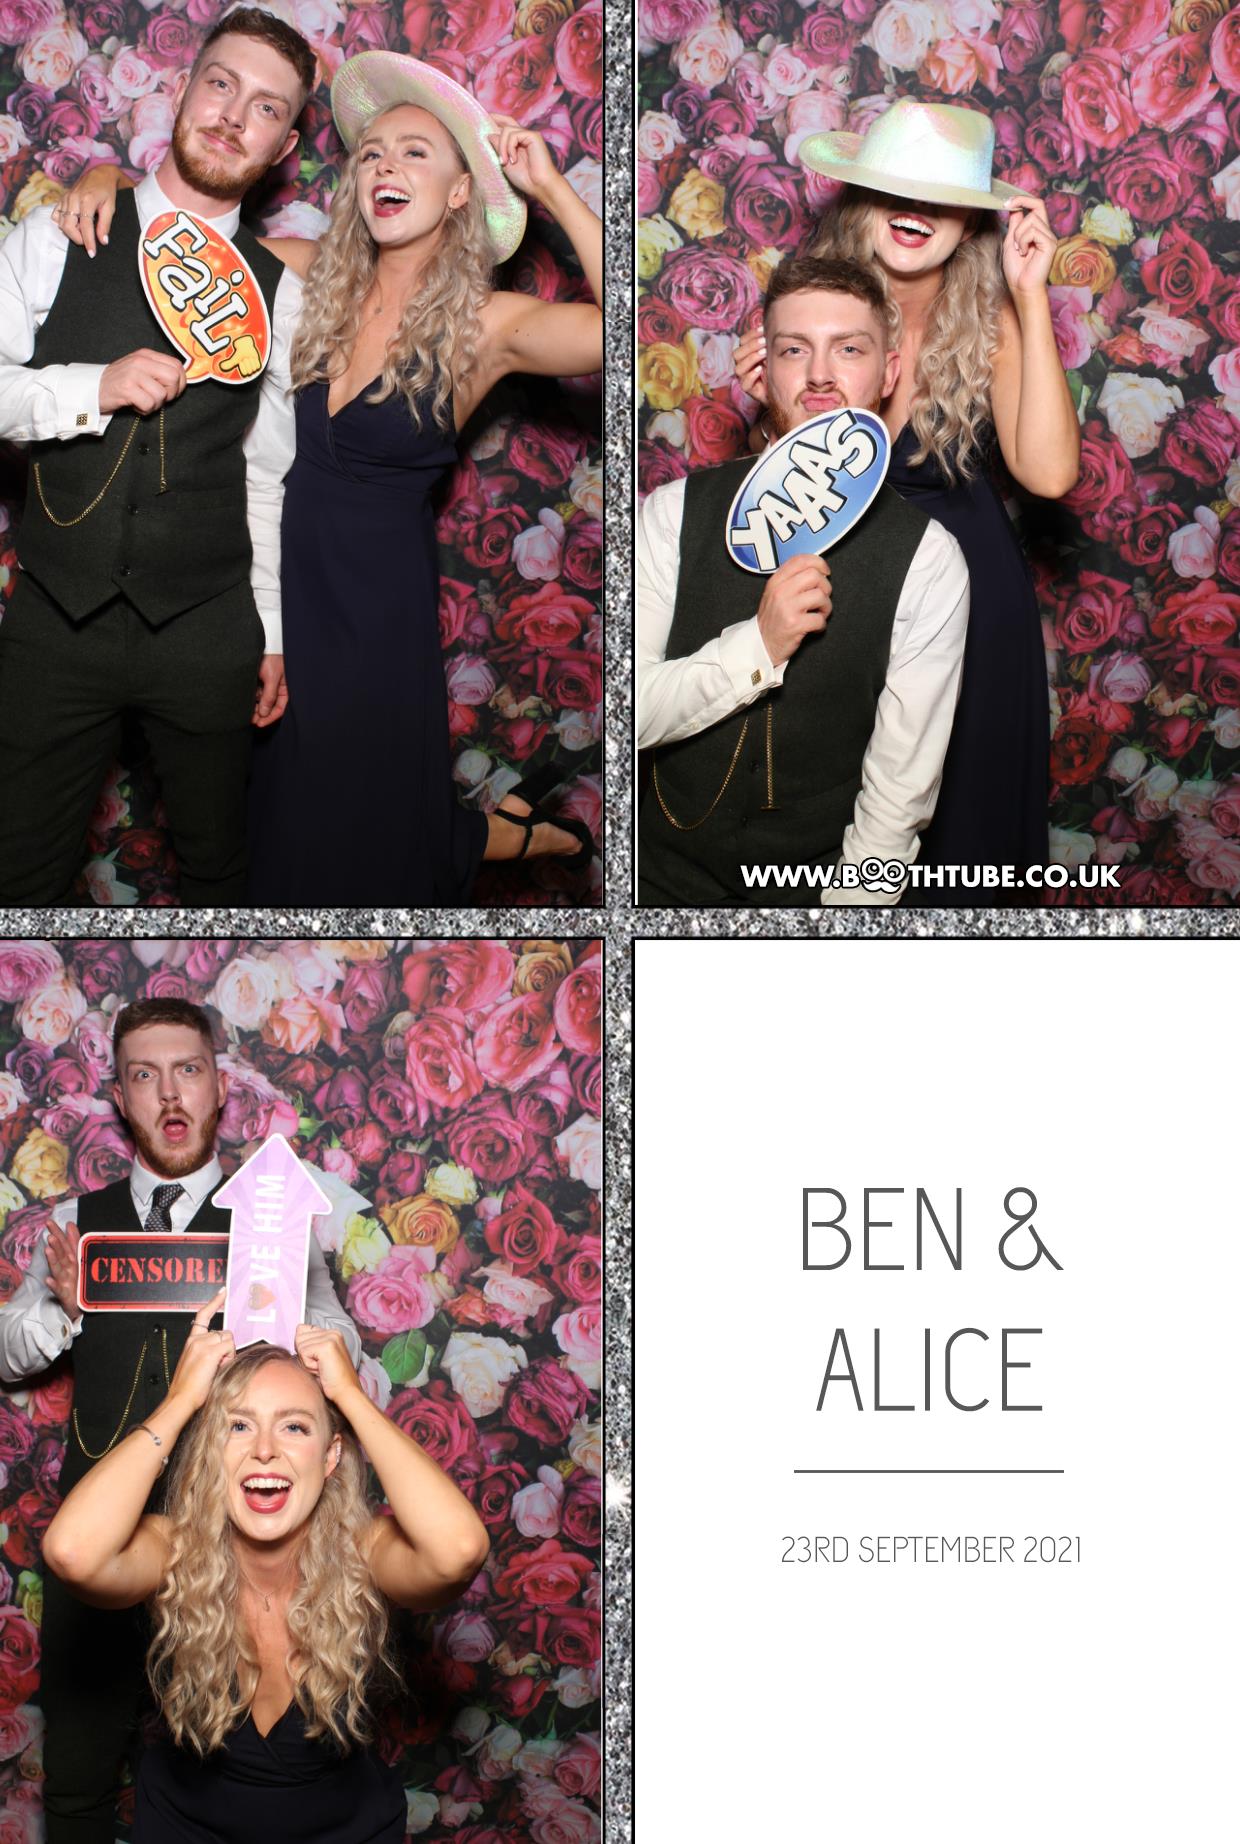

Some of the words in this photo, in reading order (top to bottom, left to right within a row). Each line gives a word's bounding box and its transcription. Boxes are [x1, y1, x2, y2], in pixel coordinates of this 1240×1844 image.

[730, 410, 878, 572] YAAAS
[252, 1174, 286, 1233] HIM
[91, 1257, 229, 1283] CENSORE
